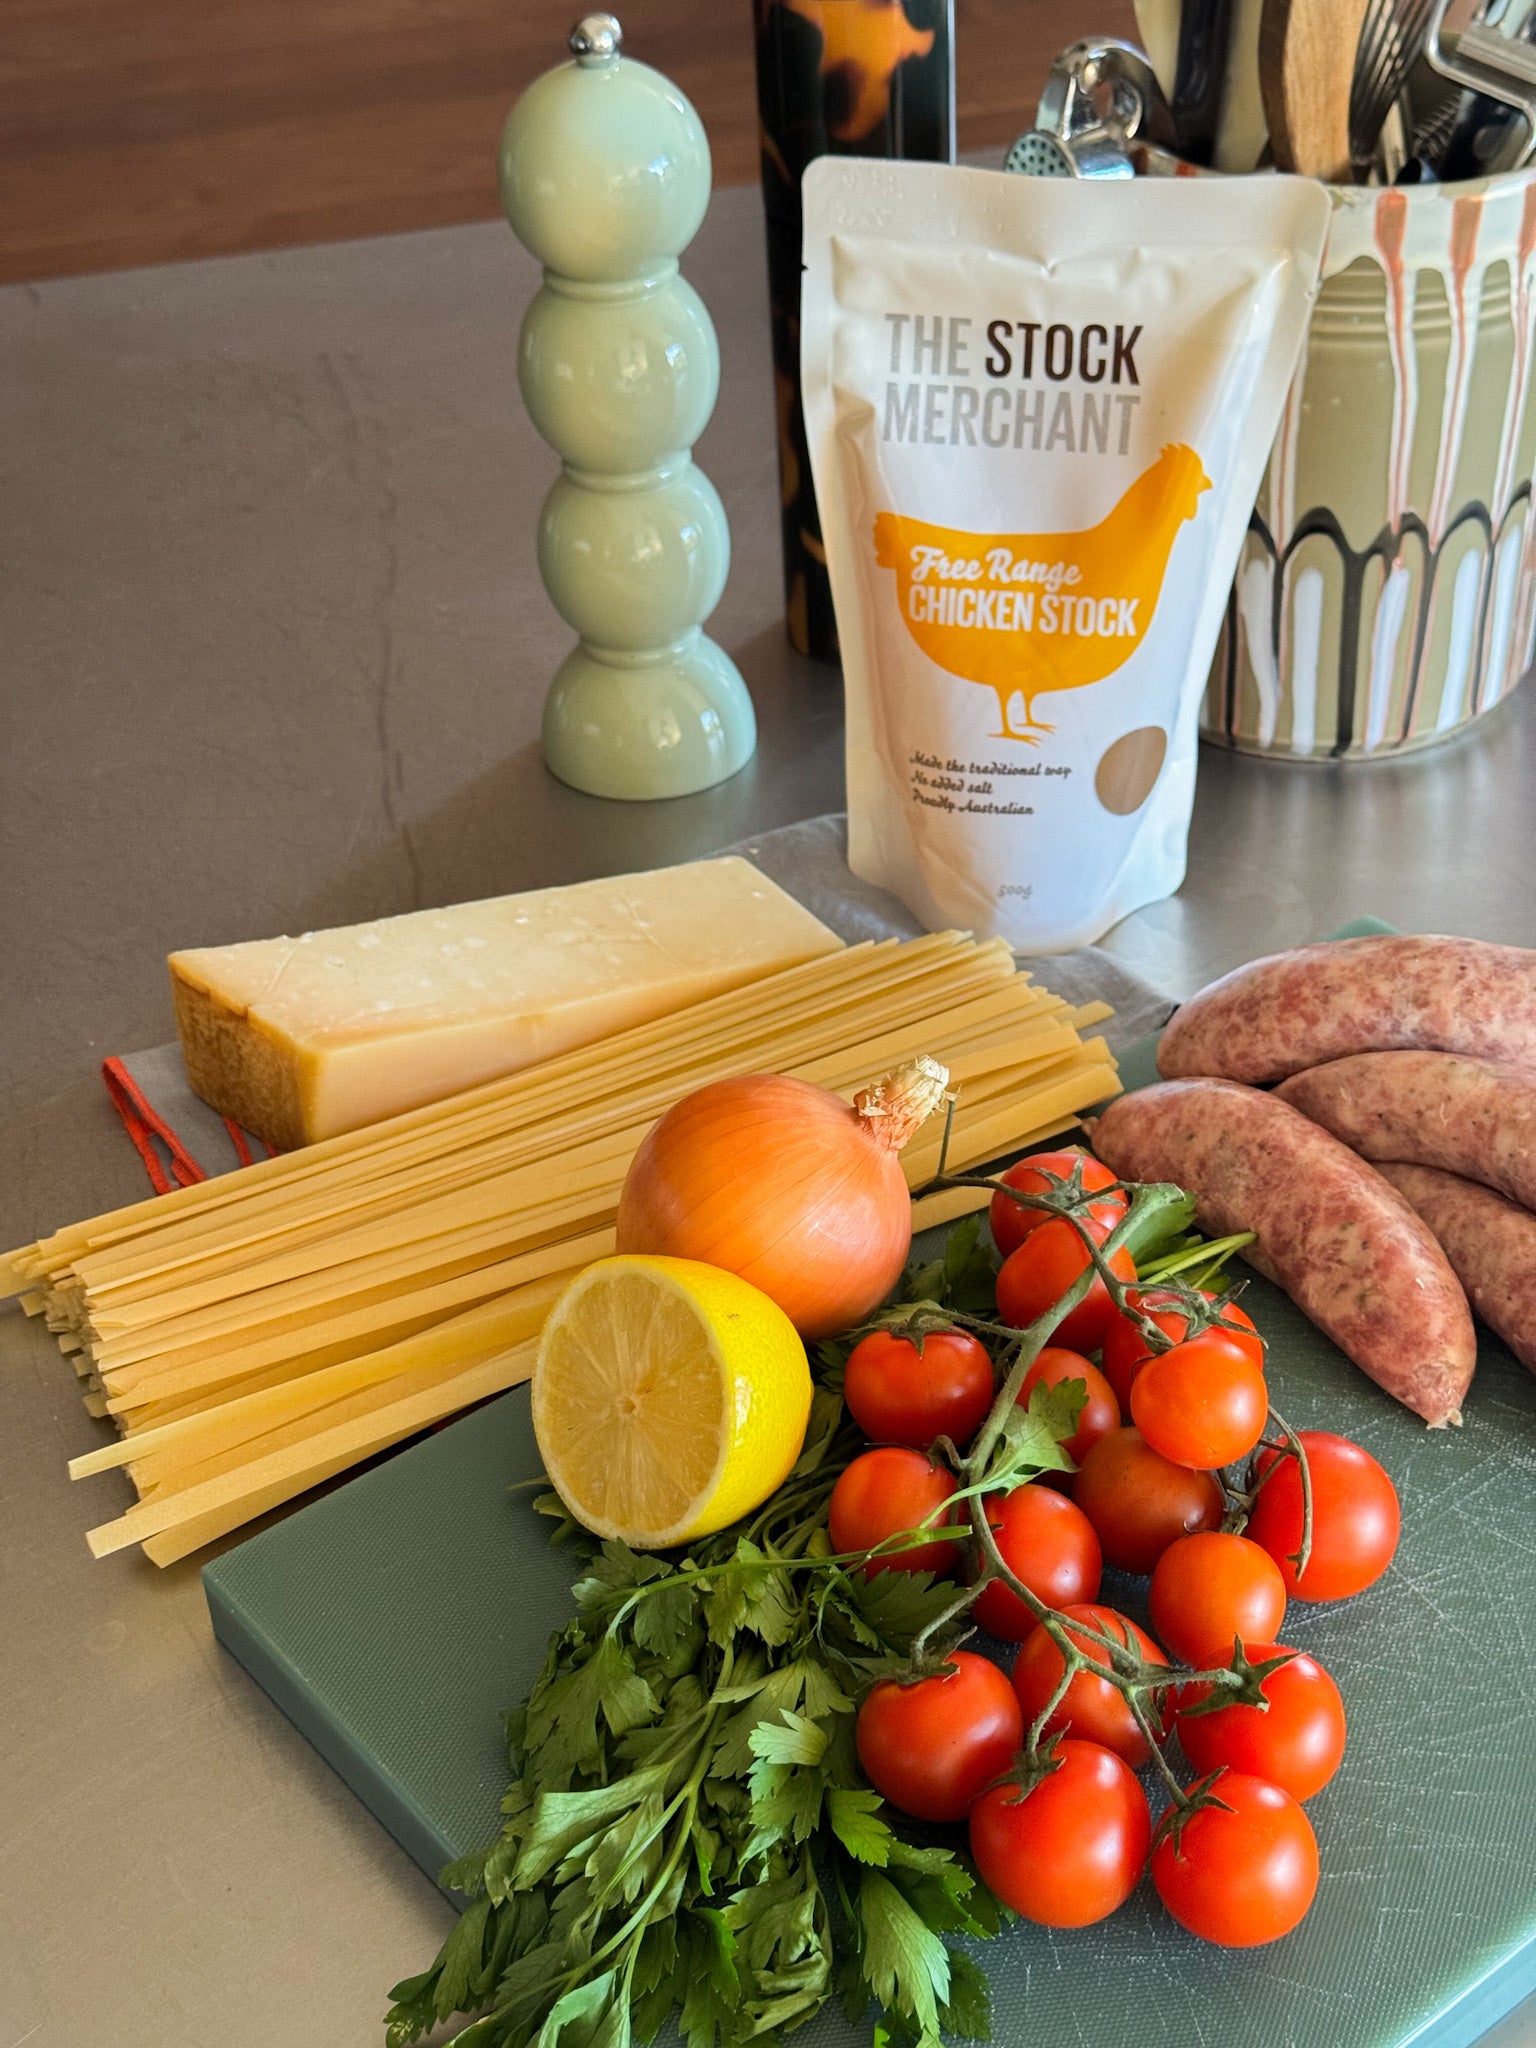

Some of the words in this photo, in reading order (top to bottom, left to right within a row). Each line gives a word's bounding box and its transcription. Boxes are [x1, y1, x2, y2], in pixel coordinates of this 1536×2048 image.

[884, 313, 972, 377] THE
[985, 320, 1144, 386] STOCK
[882, 382, 1141, 456] MERCHANT
[909, 545, 984, 582] Free
[984, 548, 1083, 591] Range
[908, 584, 1034, 632] CHICKEN
[1039, 593, 1140, 637] STOCK
[909, 751, 943, 769] Made
[946, 760, 966, 773] the
[969, 763, 1042, 776] traditional
[911, 771, 929, 784] No
[931, 777, 965, 793] added
[967, 781, 994, 795] salt
[912, 788, 956, 814] Proudly
[958, 800, 1034, 815] Australian
